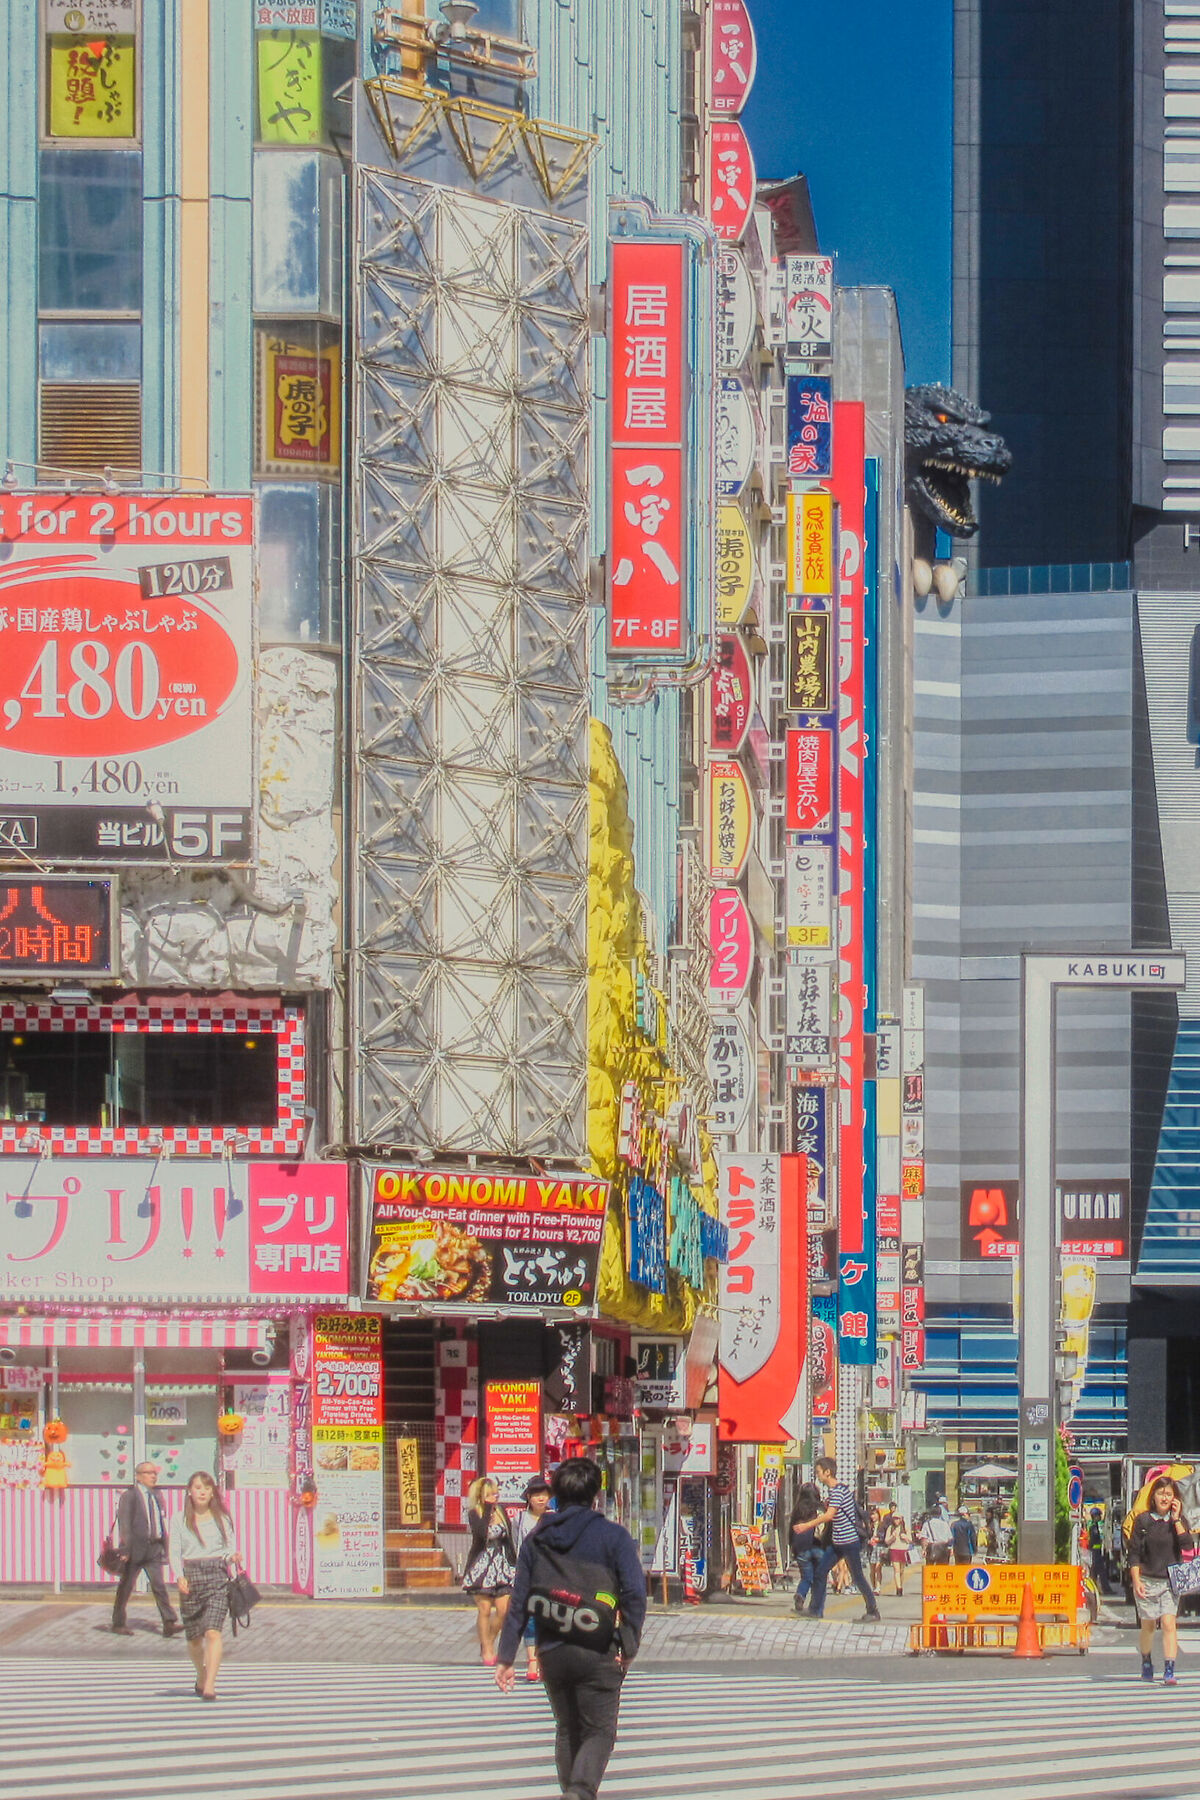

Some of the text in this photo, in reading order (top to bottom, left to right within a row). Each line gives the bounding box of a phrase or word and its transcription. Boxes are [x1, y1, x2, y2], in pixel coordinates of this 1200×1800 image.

[257, 8, 316, 25] 食べ放題
[714, 24, 747, 84] つぼ八
[714, 98, 735, 108] 8F
[712, 151, 748, 212] つぼ八
[714, 225, 738, 237] 7F
[791, 261, 815, 272] 海鮮
[791, 275, 827, 287] 居酒屋
[268, 341, 298, 354] 4F
[623, 285, 668, 429] 居酒屋
[799, 344, 818, 357] 8F
[285, 380, 317, 436] 虎の子
[789, 392, 830, 473] 海の家
[717, 481, 734, 492] 5F
[18, 502, 243, 538] for 2 hours
[611, 464, 680, 586] つぼ八
[717, 537, 745, 597] 虎の子
[145, 563, 226, 598] 120分
[794, 616, 822, 697] 山内農場
[157, 697, 207, 719] yen
[735, 705, 745, 730] 3F
[51, 760, 180, 798] 1,480 yen
[795, 735, 820, 821] 焼肉屋さかい
[98, 813, 244, 858] 当ビル 5F
[718, 781, 737, 865] お好み焼き
[817, 821, 829, 829] 4F
[718, 895, 740, 984] プリクラ
[798, 928, 820, 942] 3F
[718, 990, 737, 1001] 1F
[712, 1037, 739, 1104] かっぱ
[796, 1092, 819, 1154] 海の家
[376, 1170, 608, 1212] OKONOMI YAKI
[903, 1167, 922, 1195] 麻雀
[758, 1158, 777, 1234] 大衆酒場
[257, 1193, 336, 1236] プリ
[377, 1205, 603, 1229] All-You-Can-Eat dinner with Free-Flowing
[466, 1224, 601, 1244] Drinks for 2 hours ¥2,700
[725, 1166, 756, 1294] トラノコ
[254, 1243, 342, 1273] 専門店
[55, 1271, 115, 1292] Shop
[506, 1291, 580, 1304] TORADYU 2F
[316, 1315, 380, 1334] お好み焼き
[316, 1373, 379, 1396] 2,700円
[486, 1381, 538, 1393] OKONOMI
[499, 1393, 527, 1405] YAKI
[560, 1397, 578, 1411] 2F
[930, 1571, 954, 1582] 平日
[939, 1592, 1017, 1605] 歩行者専用
[526, 1594, 601, 1633] nyc
